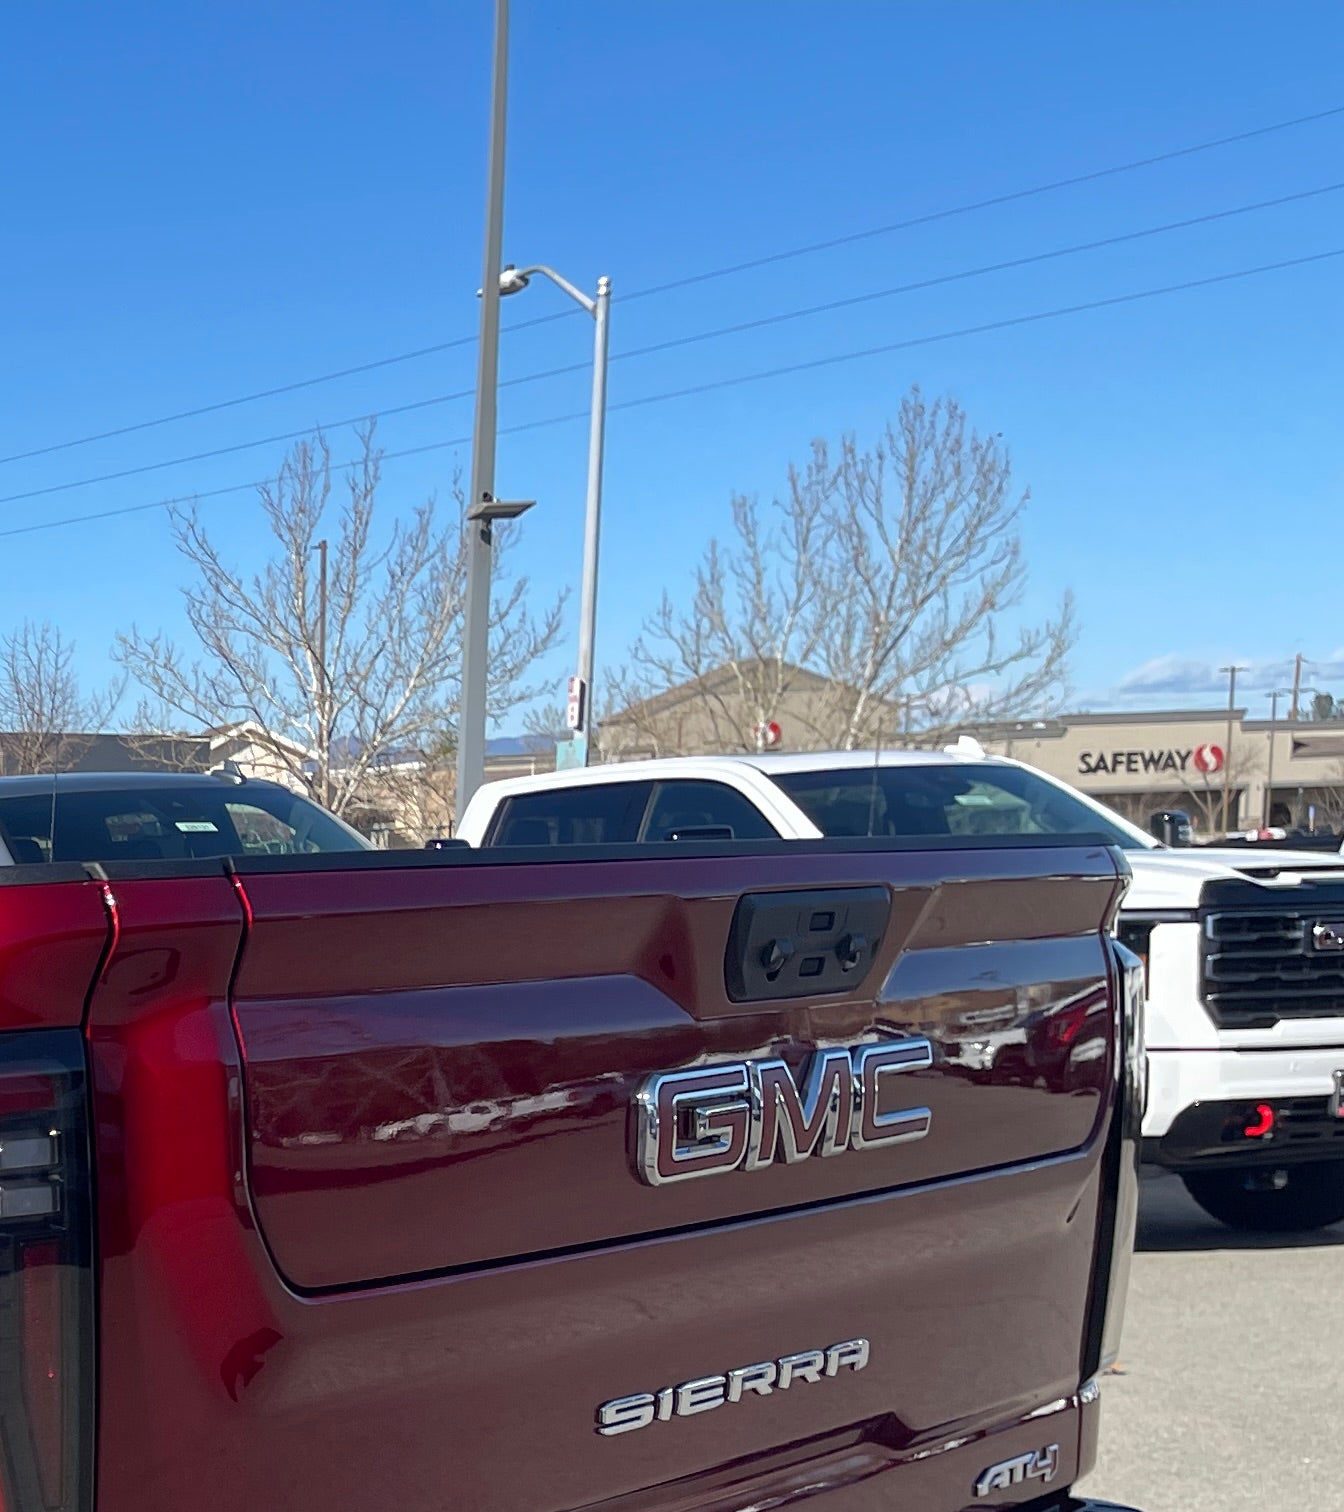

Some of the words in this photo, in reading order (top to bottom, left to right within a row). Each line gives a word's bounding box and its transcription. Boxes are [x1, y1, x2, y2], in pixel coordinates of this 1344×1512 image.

[1078, 750, 1192, 774] SAFEWAY
[626, 1035, 932, 1187] GMC
[596, 1338, 870, 1437] SIERRA
[973, 1444, 1060, 1498] AT4
